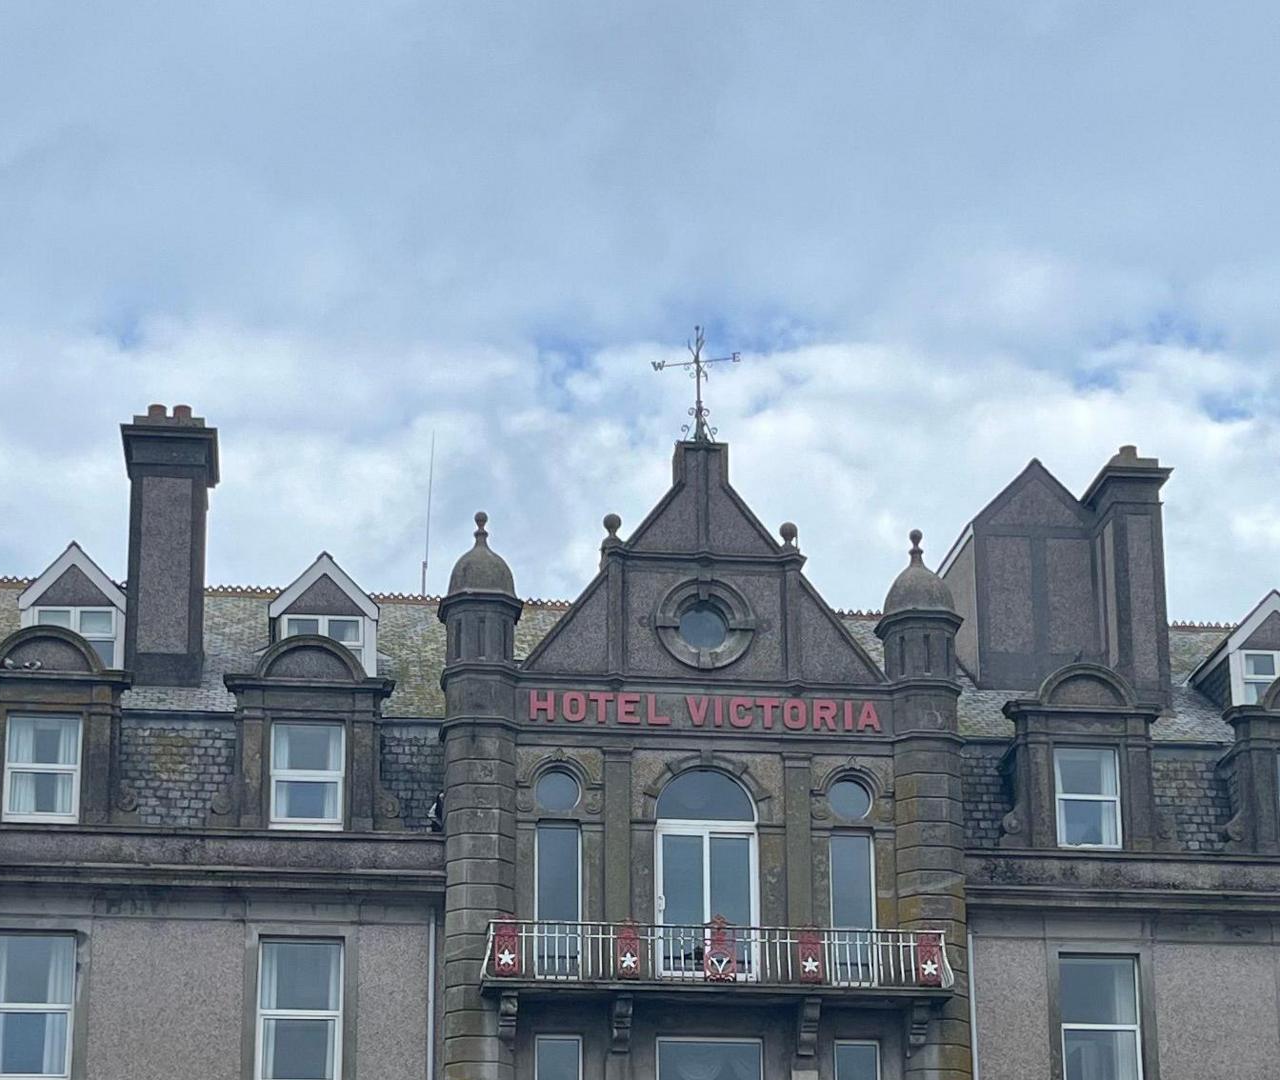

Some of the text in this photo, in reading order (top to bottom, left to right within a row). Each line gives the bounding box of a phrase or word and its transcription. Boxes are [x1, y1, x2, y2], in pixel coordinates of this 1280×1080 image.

[731, 352, 741, 362] E
[651, 360, 666, 372] W
[528, 688, 882, 732] HOTEL VICTORIA
